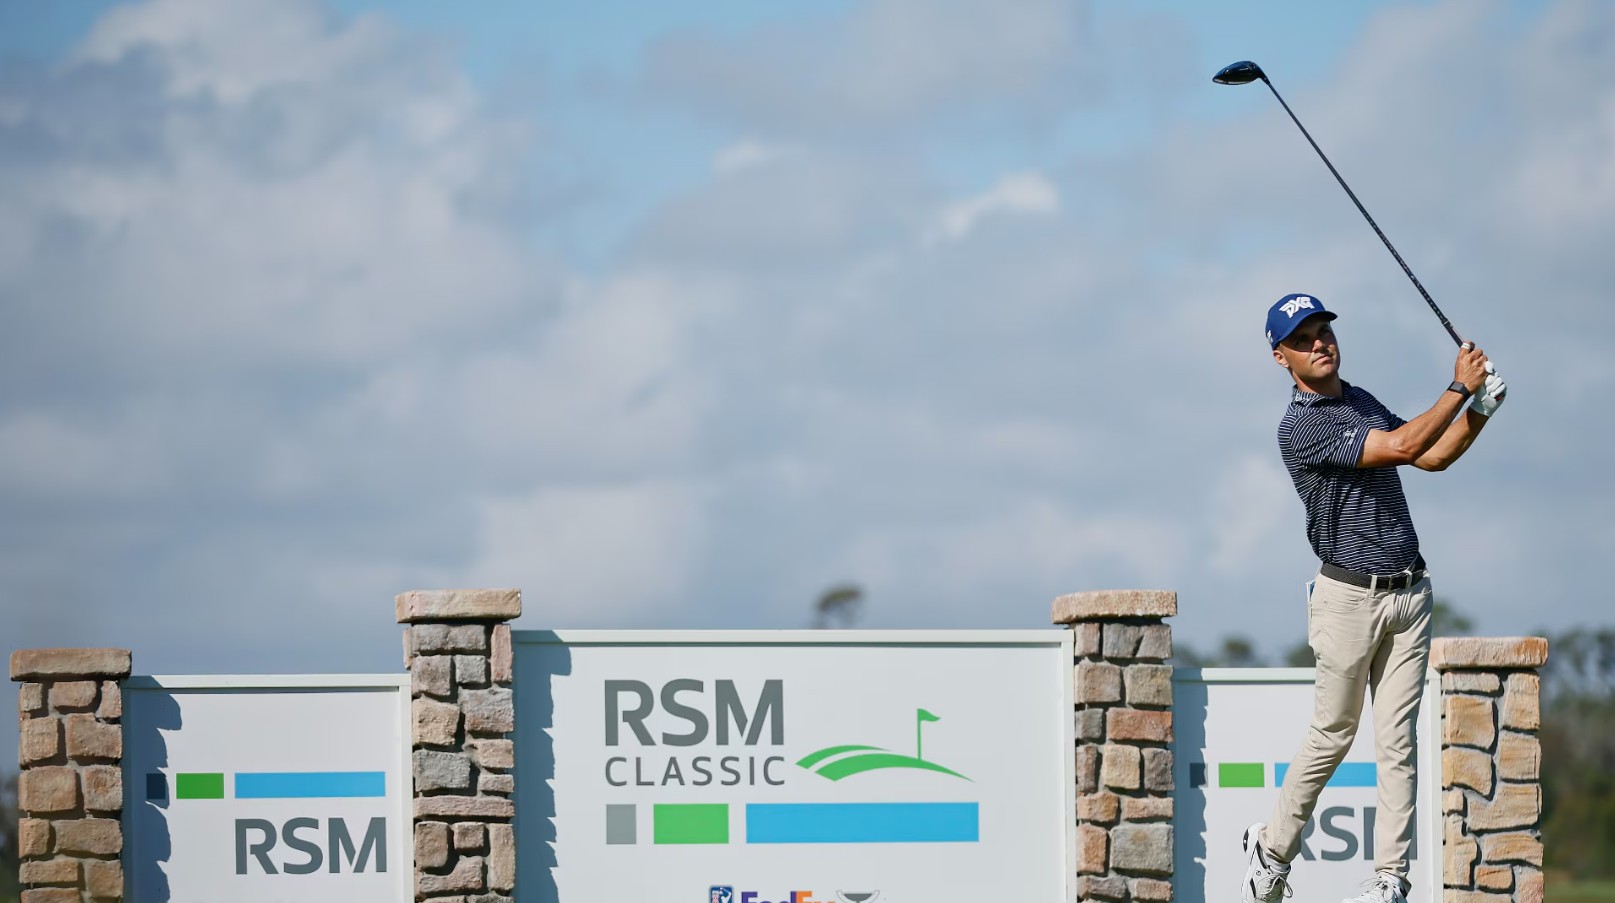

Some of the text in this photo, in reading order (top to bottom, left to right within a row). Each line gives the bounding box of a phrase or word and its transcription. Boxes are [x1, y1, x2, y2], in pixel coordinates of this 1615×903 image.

[1279, 297, 1315, 318] PXG
[605, 679, 784, 746] RSM
[605, 756, 785, 786] CLASSIC
[235, 817, 387, 875] RSM
